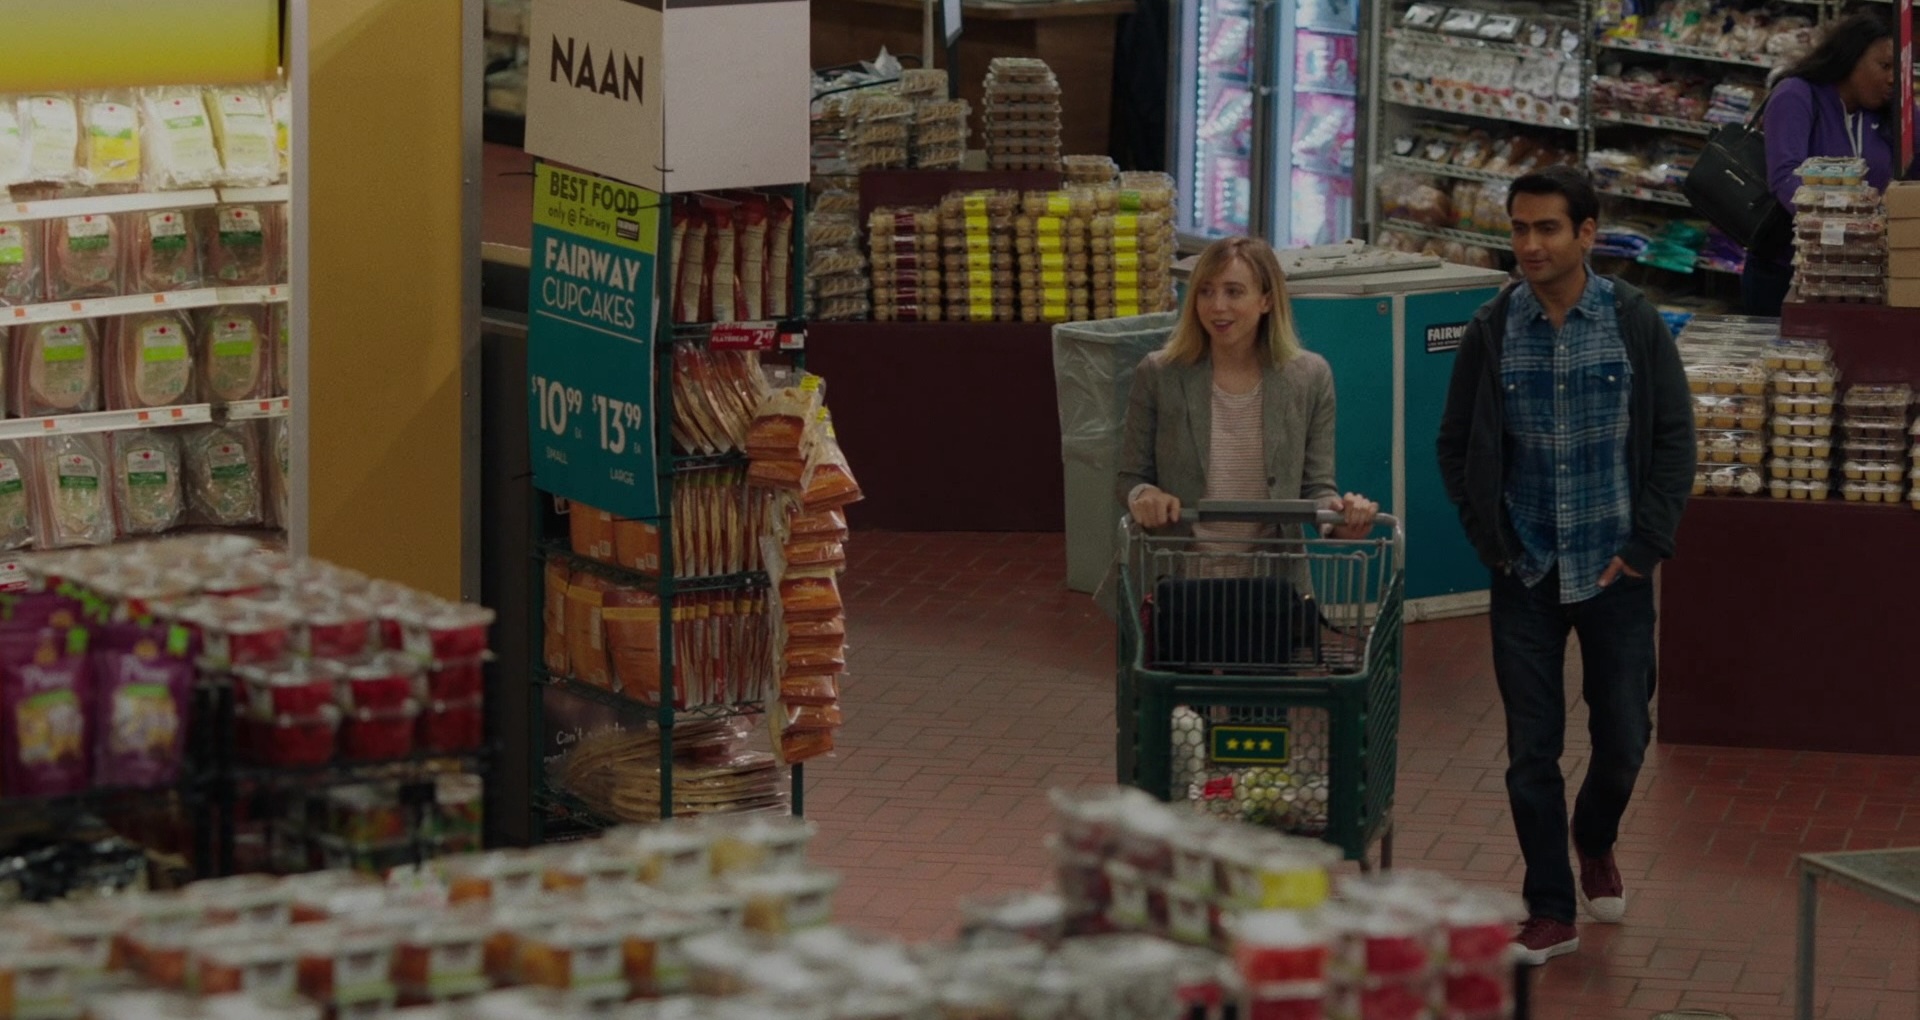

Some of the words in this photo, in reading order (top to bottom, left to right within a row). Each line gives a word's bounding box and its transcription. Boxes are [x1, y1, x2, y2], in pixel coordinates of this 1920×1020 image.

[551, 32, 643, 105] NAAN
[549, 171, 588, 204] BEST
[592, 182, 638, 216] FOOD
[548, 201, 565, 225] only
[568, 208, 576, 227] @
[580, 207, 611, 236] Fairway
[545, 236, 641, 293] FAIRWAY
[542, 275, 635, 329] CUPCAKES
[1427, 325, 1467, 341] FAIRW
[546, 445, 568, 465] SMALL
[609, 467, 635, 486] LARGE
[556, 727, 583, 745] Can't
